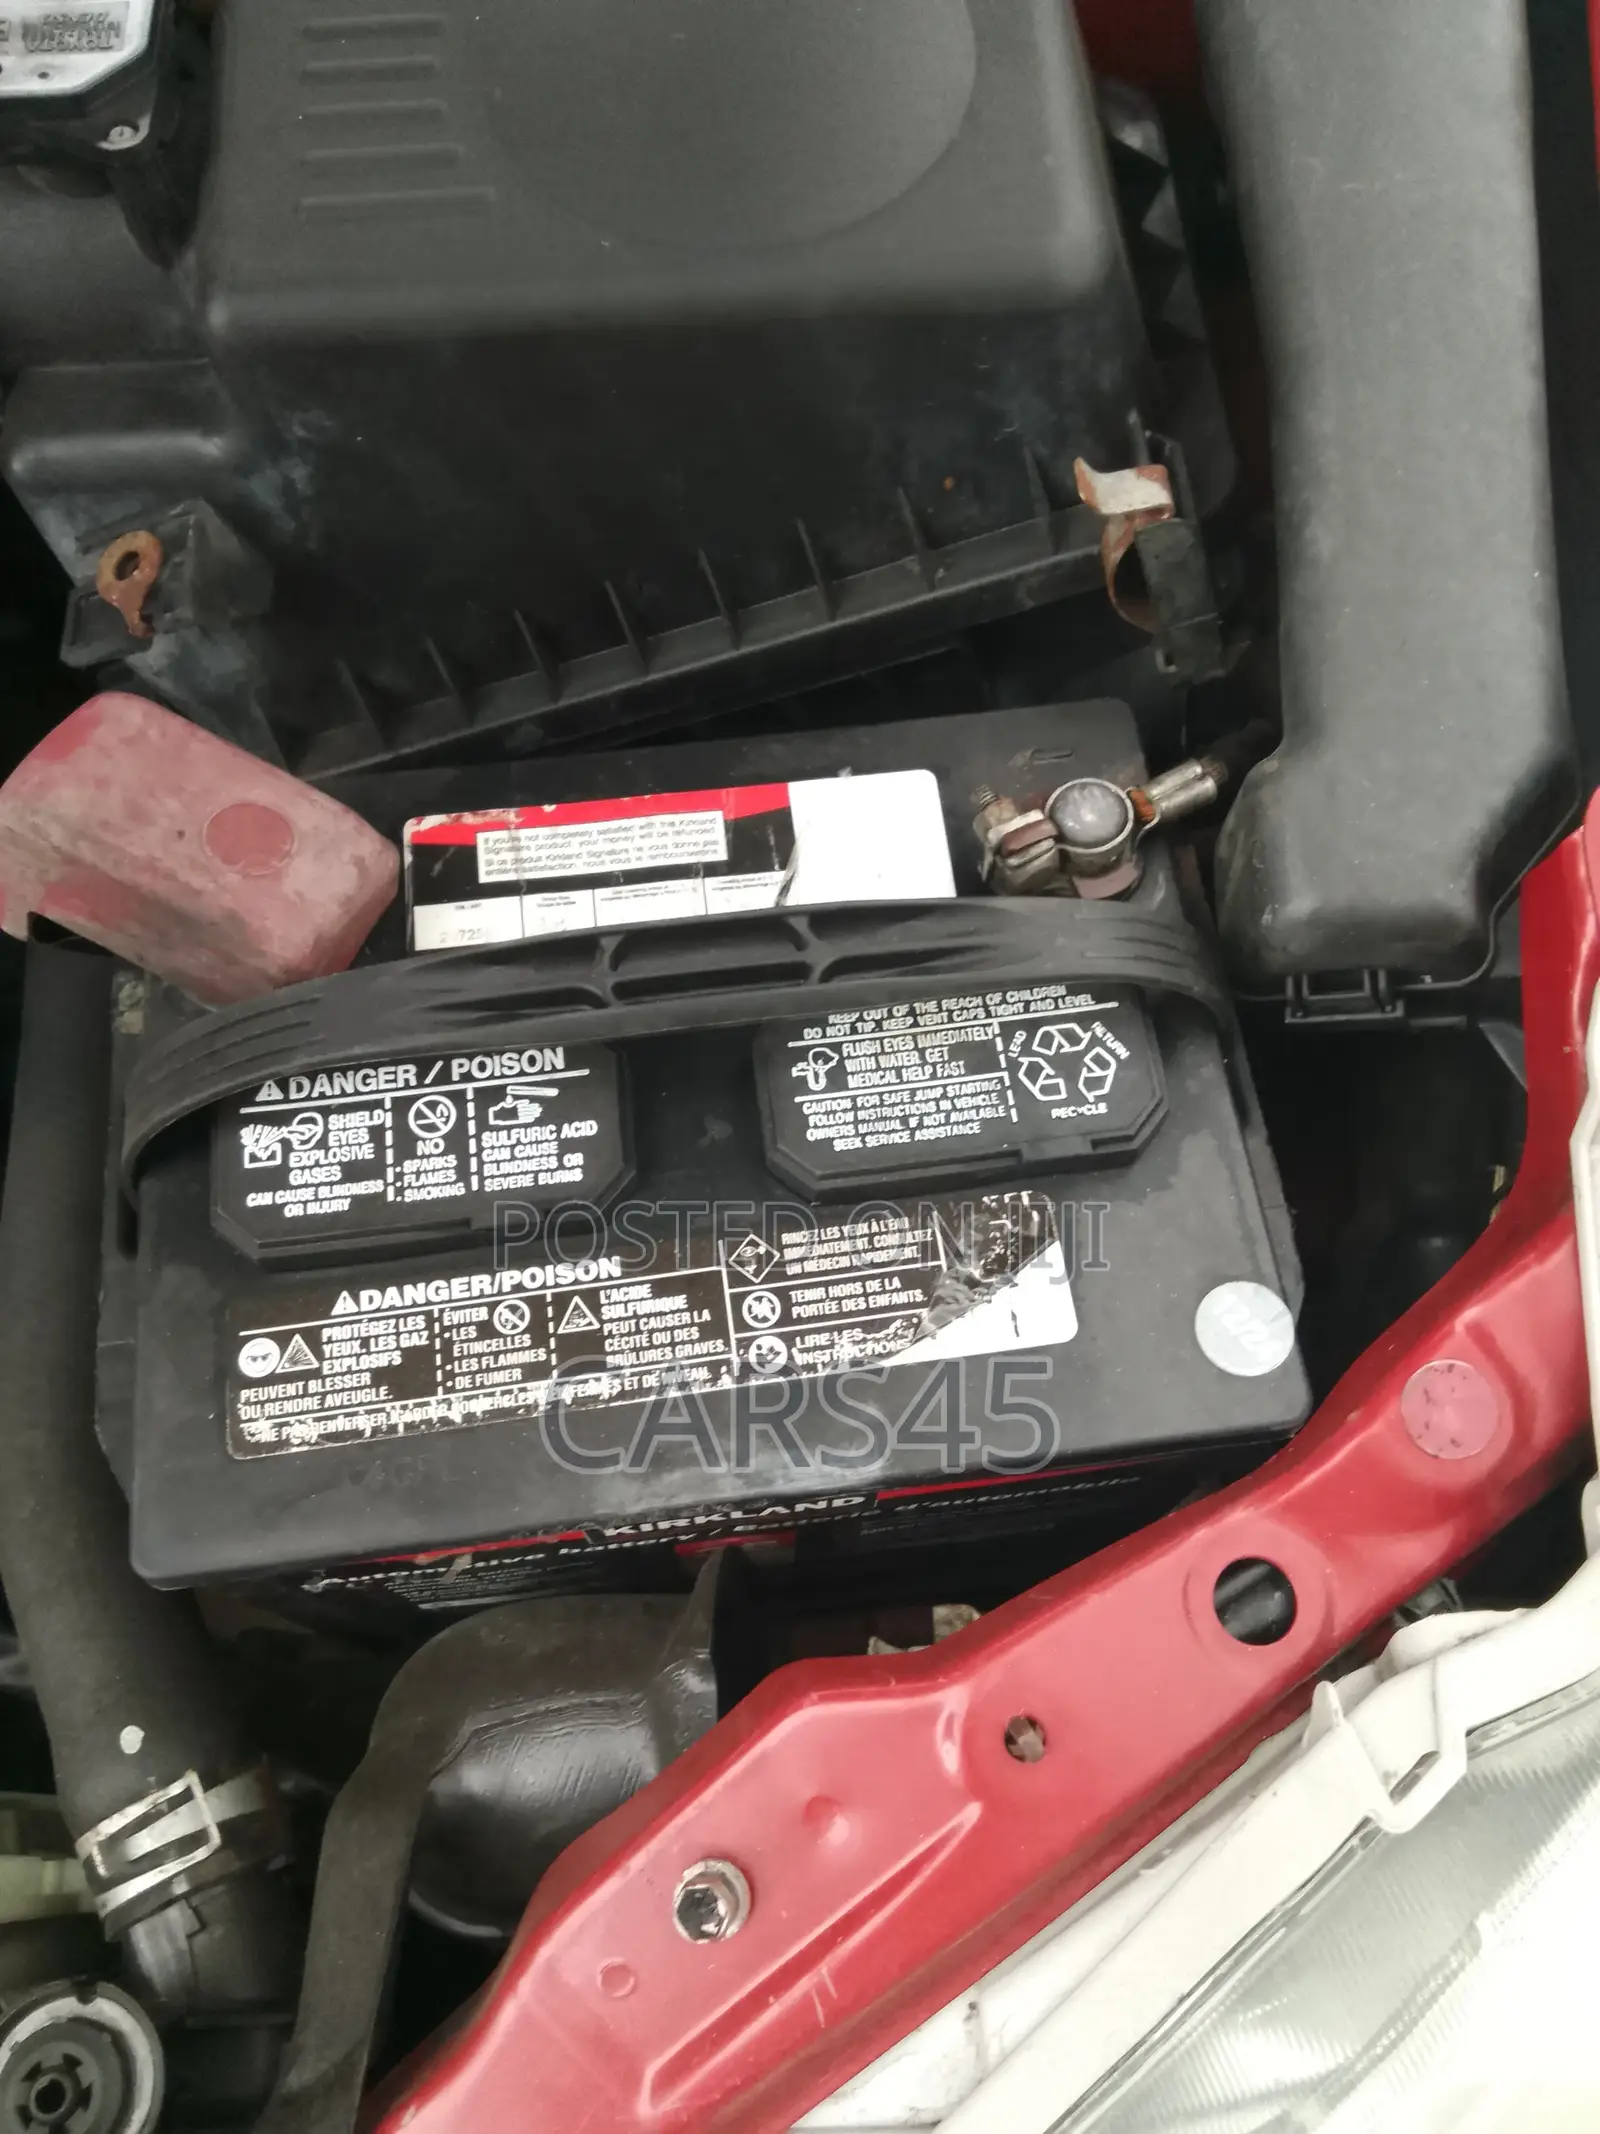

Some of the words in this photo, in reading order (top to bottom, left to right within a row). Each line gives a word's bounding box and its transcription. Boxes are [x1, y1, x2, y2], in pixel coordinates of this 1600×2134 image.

[803, 1027, 823, 1040] DO
[825, 1023, 851, 1037] NOT
[881, 1016, 914, 1031] KEEP
[916, 1012, 949, 1027] VENT
[952, 1007, 986, 1022] CAPS
[989, 1002, 1025, 1018] TIGHT
[1029, 998, 1055, 1013] AND
[1058, 993, 1096, 1009] LEVEL
[828, 1012, 860, 1024] KEEP
[862, 1007, 889, 1021] OUT
[892, 1004, 910, 1017] OF
[912, 1000, 939, 1015] THE
[941, 996, 983, 1011] REACH
[985, 992, 1003, 1006] OF
[1005, 984, 1067, 1003] CHILDREN
[842, 1040, 881, 1058] FLUSH
[883, 1035, 915, 1053] EYES
[916, 1025, 994, 1049] IMMEDIATELY
[1007, 1030, 1028, 1058] LEAD
[1090, 1021, 1131, 1060] RETURN
[288, 1064, 417, 1100] DANGER
[423, 1060, 444, 1084] /
[451, 1046, 565, 1082] POISON
[844, 1056, 876, 1073] WITH
[924, 1046, 949, 1063] GET
[847, 1069, 900, 1089] MEDICAL
[901, 1064, 933, 1082] HELP
[935, 1060, 965, 1078] FAST
[856, 1095, 880, 1108] FOR
[882, 1090, 911, 1105] SAFE
[913, 1087, 944, 1101] JUMP
[946, 1079, 1001, 1097] STARTING
[328, 1109, 385, 1130] SHIELD
[806, 1124, 855, 1142] OWNERS
[908, 1116, 919, 1128] IF
[922, 1113, 946, 1126] NOT
[949, 1105, 1007, 1123] AVAILABLE
[808, 1111, 854, 1127] FOLLOW
[857, 1101, 937, 1120] INSTRUCTIONS
[939, 1098, 952, 1110] IN
[953, 1092, 1000, 1110] VEHICLE
[1051, 1102, 1108, 1120] RECYCLE
[328, 1127, 370, 1147] EYES
[416, 1138, 445, 1156] NO
[481, 1124, 557, 1148] SULFURIC
[560, 1119, 599, 1139] ACID
[832, 1137, 863, 1152] SEEK
[864, 1130, 911, 1148] SERVICE
[914, 1122, 982, 1141] ASSISTANCE
[289, 1143, 375, 1168] EXPLOSIVE
[403, 1155, 457, 1174] SPARKS
[482, 1148, 511, 1162] CAN
[513, 1141, 559, 1159] CAUSE
[483, 1155, 558, 1177] BLINDNESS
[562, 1152, 584, 1168] OR
[289, 1165, 342, 1186] GASES
[403, 1169, 457, 1188] FLAMES
[484, 1174, 535, 1192] SEVERE
[538, 1168, 584, 1186] BURNS
[246, 1191, 273, 1207] CAN
[275, 1187, 316, 1204] CAUSE
[318, 1179, 385, 1199] BLINDNESS
[403, 1182, 466, 1203] SMOKING
[284, 1203, 304, 1218] OR
[306, 1197, 351, 1215] INJURY
[358, 1256, 622, 1312] DANGER/POISON
[600, 1283, 653, 1305] L'ACIDE
[789, 1287, 826, 1304] TENIR
[828, 1281, 863, 1298] HORS
[864, 1278, 883, 1293] DE
[884, 1276, 902, 1292] LA
[443, 1306, 489, 1326] ÉVITER
[601, 1294, 688, 1320] SULFURIQUE
[791, 1299, 840, 1319] PORTÉE
[841, 1296, 867, 1312] DES
[868, 1289, 928, 1309] ENFANTS.
[321, 1319, 397, 1343] PROTÉGEZ
[398, 1314, 427, 1333] LES
[452, 1325, 477, 1341] LES
[603, 1319, 637, 1336] PEUT
[639, 1311, 692, 1331] CAUSER
[693, 1308, 712, 1323] LA
[321, 1339, 367, 1359] YEUX.
[369, 1335, 397, 1352] LES
[399, 1330, 430, 1348] GAZ
[453, 1333, 532, 1357] ÉTINCELLES
[604, 1331, 650, 1352] CÉCITÉ
[652, 1331, 672, 1346] OU
[673, 1326, 700, 1342] DES
[322, 1351, 402, 1376] EXPLOSIFS
[454, 1357, 479, 1374] LES
[481, 1347, 547, 1369] FLAMMES
[606, 1346, 673, 1369] BRÛLURES
[675, 1339, 729, 1359] GRAVES.
[240, 1381, 306, 1403] PEUVENT
[308, 1372, 371, 1393] BLESSER
[455, 1375, 473, 1390] DE
[475, 1368, 523, 1387] FUMER
[240, 1403, 262, 1420] OU
[264, 1395, 322, 1417] RENDRE
[324, 1386, 393, 1409] AVEUGLE.
[603, 1496, 866, 1537] KIRKLAND
[312, 1553, 546, 1585] Automtive
[558, 1533, 698, 1555] battery
